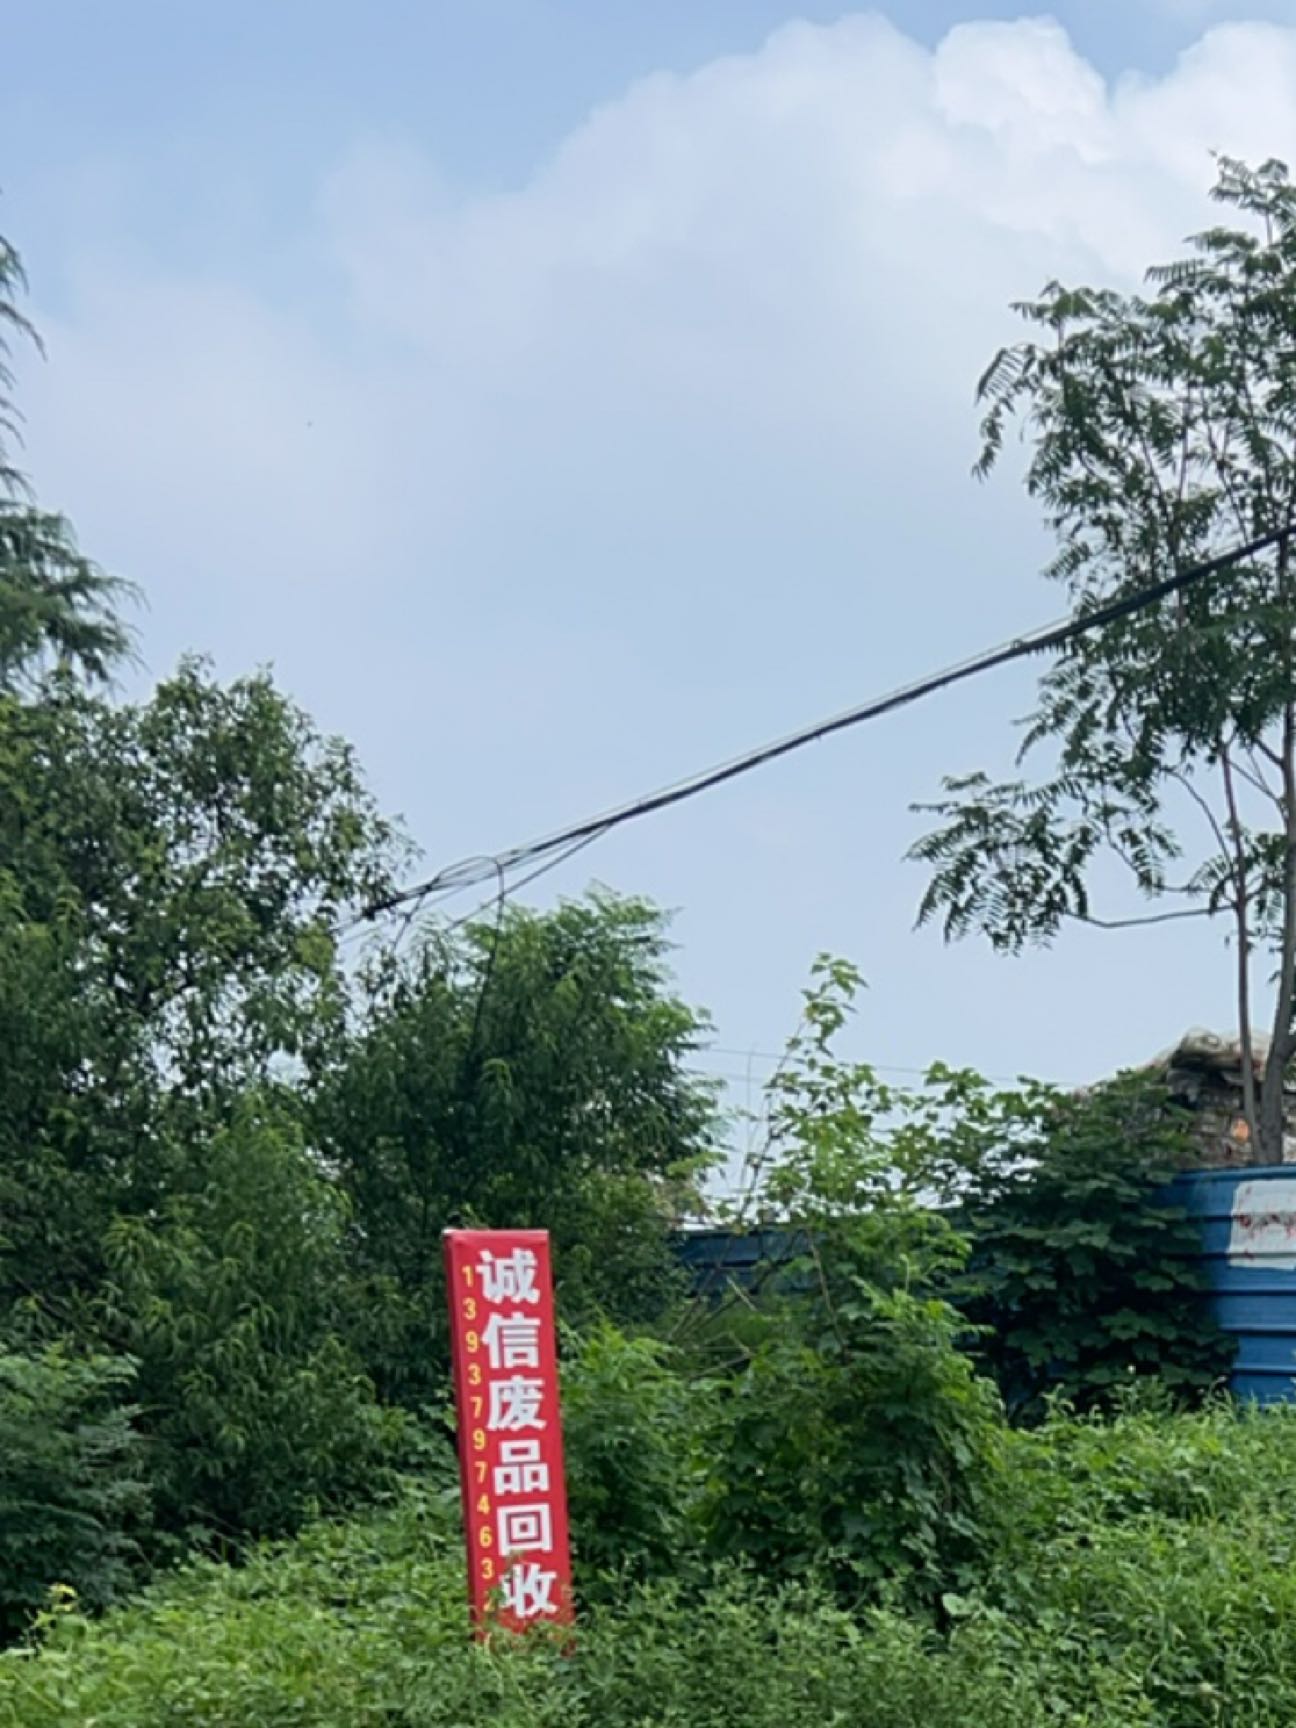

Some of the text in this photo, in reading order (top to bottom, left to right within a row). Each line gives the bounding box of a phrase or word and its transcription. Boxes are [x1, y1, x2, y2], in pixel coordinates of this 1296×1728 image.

[475, 1247, 559, 1619] 诚信废品回收
